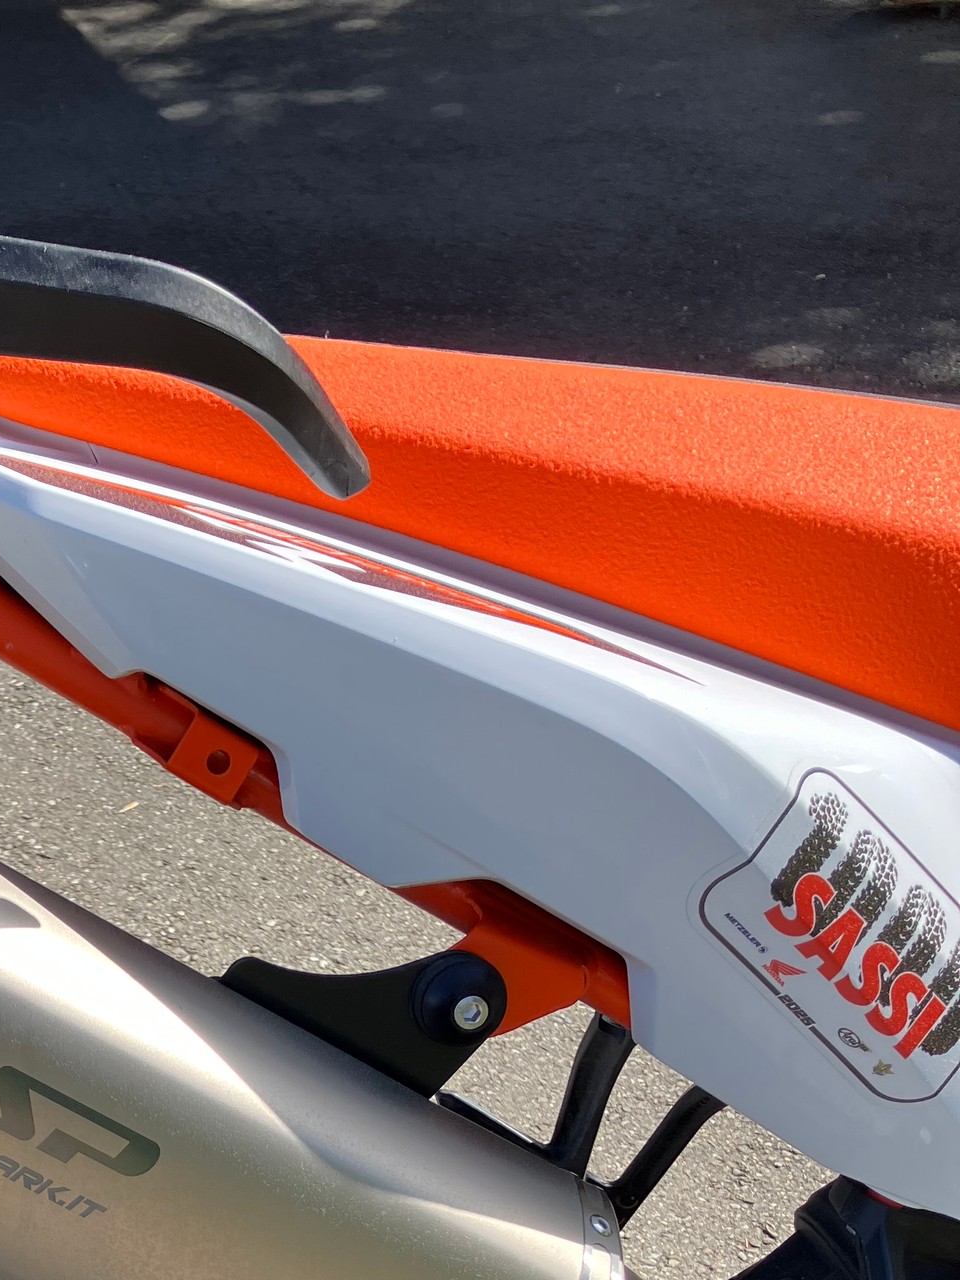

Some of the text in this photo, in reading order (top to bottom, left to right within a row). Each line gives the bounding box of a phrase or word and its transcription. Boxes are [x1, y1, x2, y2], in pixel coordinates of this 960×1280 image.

[724, 912, 761, 950] METZELER
[761, 963, 786, 988] HONDA
[763, 871, 947, 1060] SASSI
[840, 1028, 859, 1047] Arai
